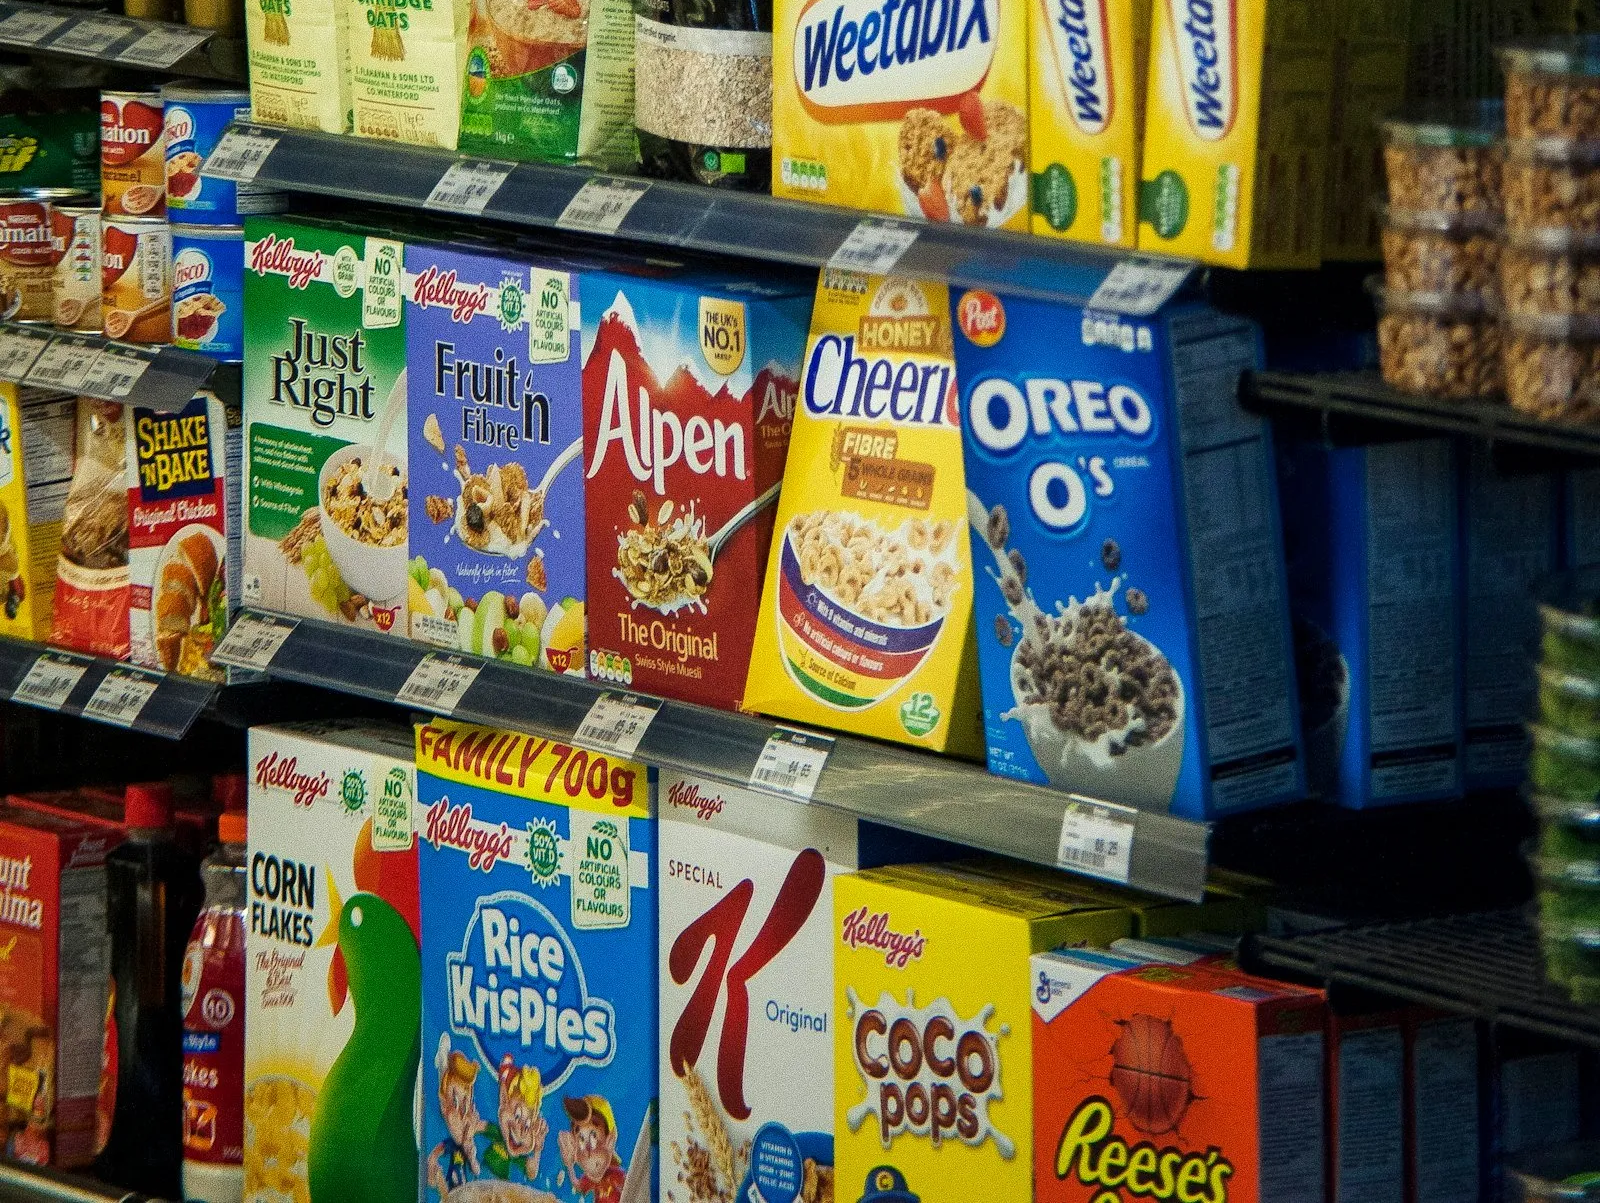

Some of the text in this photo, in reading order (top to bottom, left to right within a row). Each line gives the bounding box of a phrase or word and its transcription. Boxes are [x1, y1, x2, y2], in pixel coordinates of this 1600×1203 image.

[366, 9, 410, 31] OATS
[251, 235, 324, 288] Kellogg's
[373, 257, 391, 276] NO
[368, 284, 396, 299] COLOURS
[369, 275, 395, 287] ARTIFICIAL
[413, 267, 489, 323] Kellogg's
[365, 305, 397, 319] FLAVOURS
[376, 296, 386, 306] OR
[541, 291, 559, 310] NO
[965, 297, 998, 332] Post
[535, 319, 565, 332] COLOURS
[536, 309, 563, 322] ARTIFICIAL
[705, 311, 719, 324] THE
[284, 318, 365, 373] Just
[533, 339, 566, 354] FLAVOURS
[544, 331, 554, 341] OR
[704, 324, 740, 353] NO.1
[862, 320, 937, 348] HONEY
[435, 341, 521, 410] Fruit
[269, 356, 376, 426] Right
[462, 407, 520, 450] Fibre
[586, 347, 748, 496] Alpen
[970, 378, 1152, 450] OREO
[137, 415, 208, 459] SHAKE
[842, 431, 897, 460] FIBRE
[155, 448, 211, 492] BAKE
[847, 457, 896, 482] 5 WHOLE
[133, 498, 218, 534] Original Chicken
[376, 612, 392, 626] x12
[617, 612, 719, 662] The Original
[551, 653, 568, 667] x12
[635, 653, 702, 680] Swiss Style Muesli
[808, 657, 828, 678] Source
[834, 671, 857, 692] Calcium
[909, 692, 933, 720] 12
[255, 751, 331, 807] Kellogg's
[419, 725, 637, 807] FAMILY 700g
[384, 779, 403, 798] NO
[668, 780, 725, 821] Kellogg's
[377, 806, 408, 822] COLOURS
[378, 798, 408, 811] ARTIFICIAL
[375, 825, 409, 843] FLAVOURS
[387, 818, 397, 829] OR
[426, 796, 513, 872] Kellogg's
[532, 832, 555, 849] 50%
[586, 836, 613, 861] NO
[251, 851, 315, 910] CORN
[578, 872, 622, 890] COLOURS
[579, 861, 621, 877] ARTIFICIAL
[669, 859, 724, 890] SPECIAL
[576, 898, 624, 918] FLAVOURS
[593, 887, 607, 901] OR
[251, 900, 314, 948] FLAKES
[841, 906, 926, 968] Kellogg's
[480, 906, 566, 985] Rice
[669, 847, 827, 1122] K
[450, 963, 610, 1058] Krispies
[765, 999, 828, 1034] Original
[880, 1081, 982, 1146] pops
[1056, 1098, 1233, 1203] Reese's
